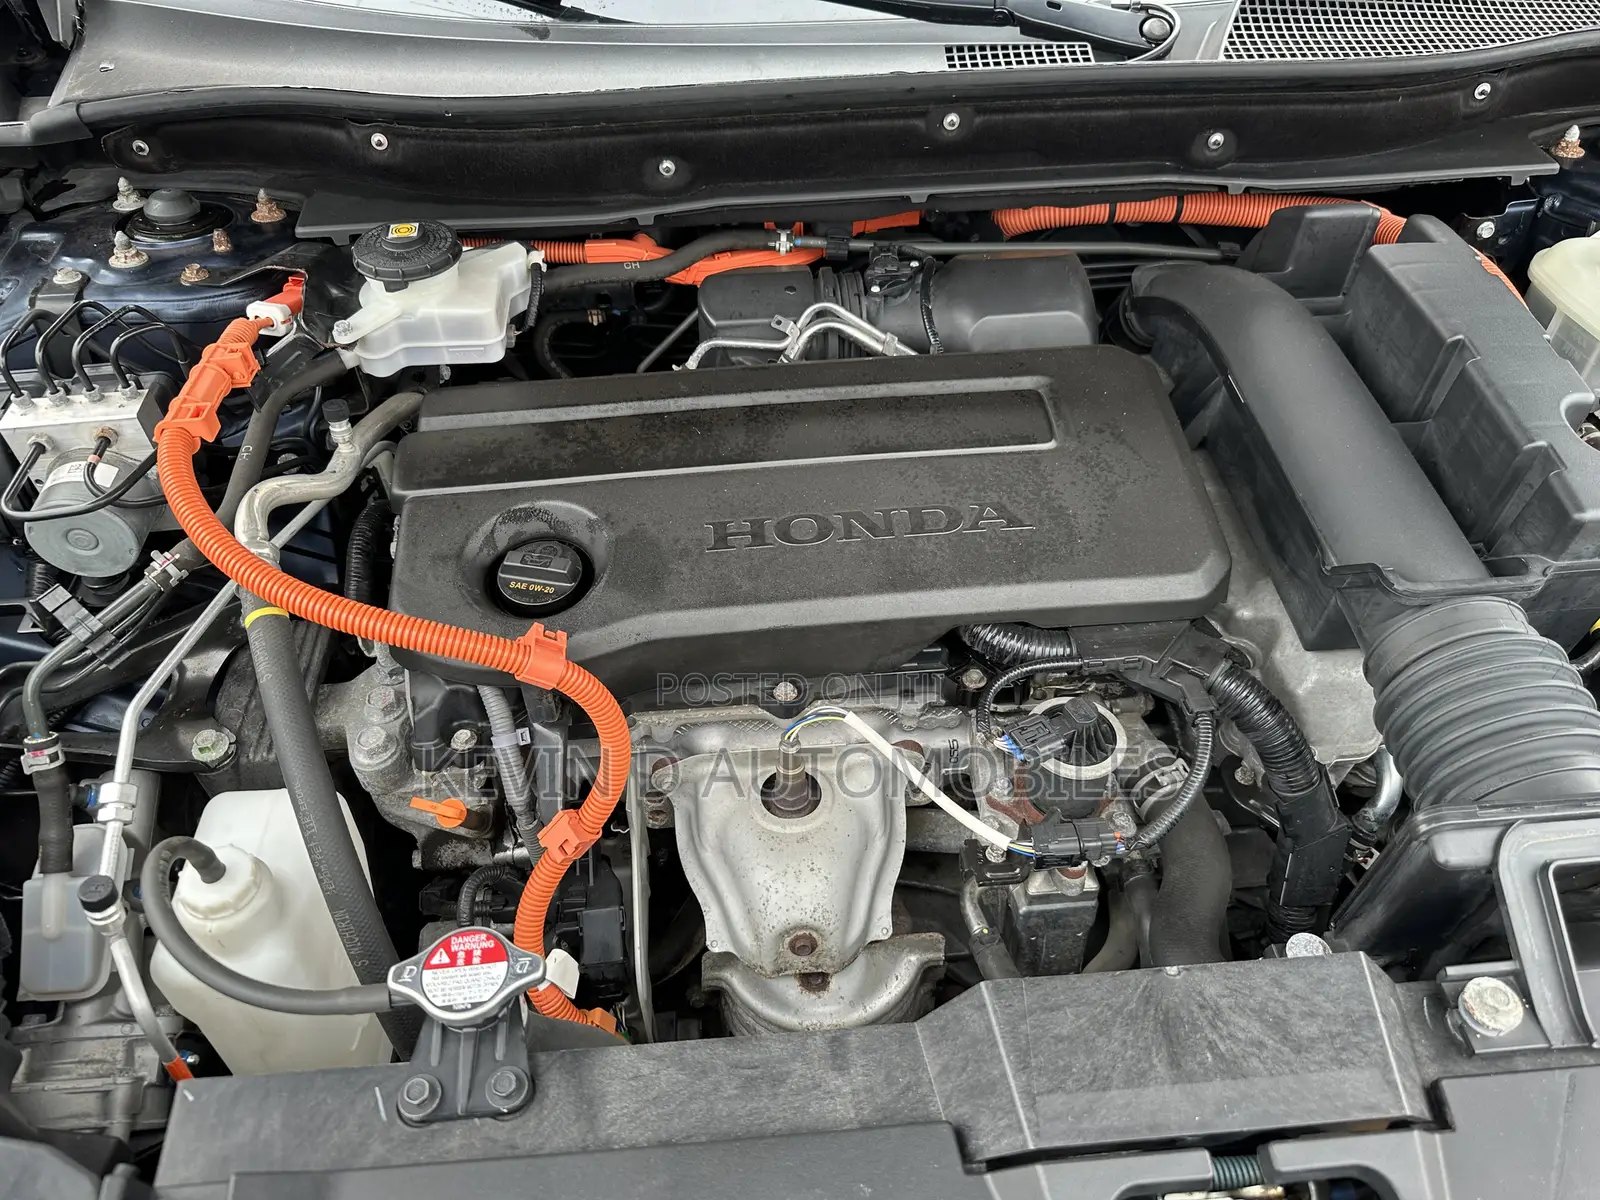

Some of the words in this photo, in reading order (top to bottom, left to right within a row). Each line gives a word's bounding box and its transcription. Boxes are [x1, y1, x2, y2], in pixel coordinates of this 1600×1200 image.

[623, 261, 641, 270] CH
[704, 501, 1036, 552] HONDA
[509, 581, 527, 590] SAE
[528, 584, 555, 594] 0W-20
[333, 908, 364, 955] NICHIRIN
[451, 933, 488, 944] DANGER
[451, 939, 495, 952] WARNUNG
